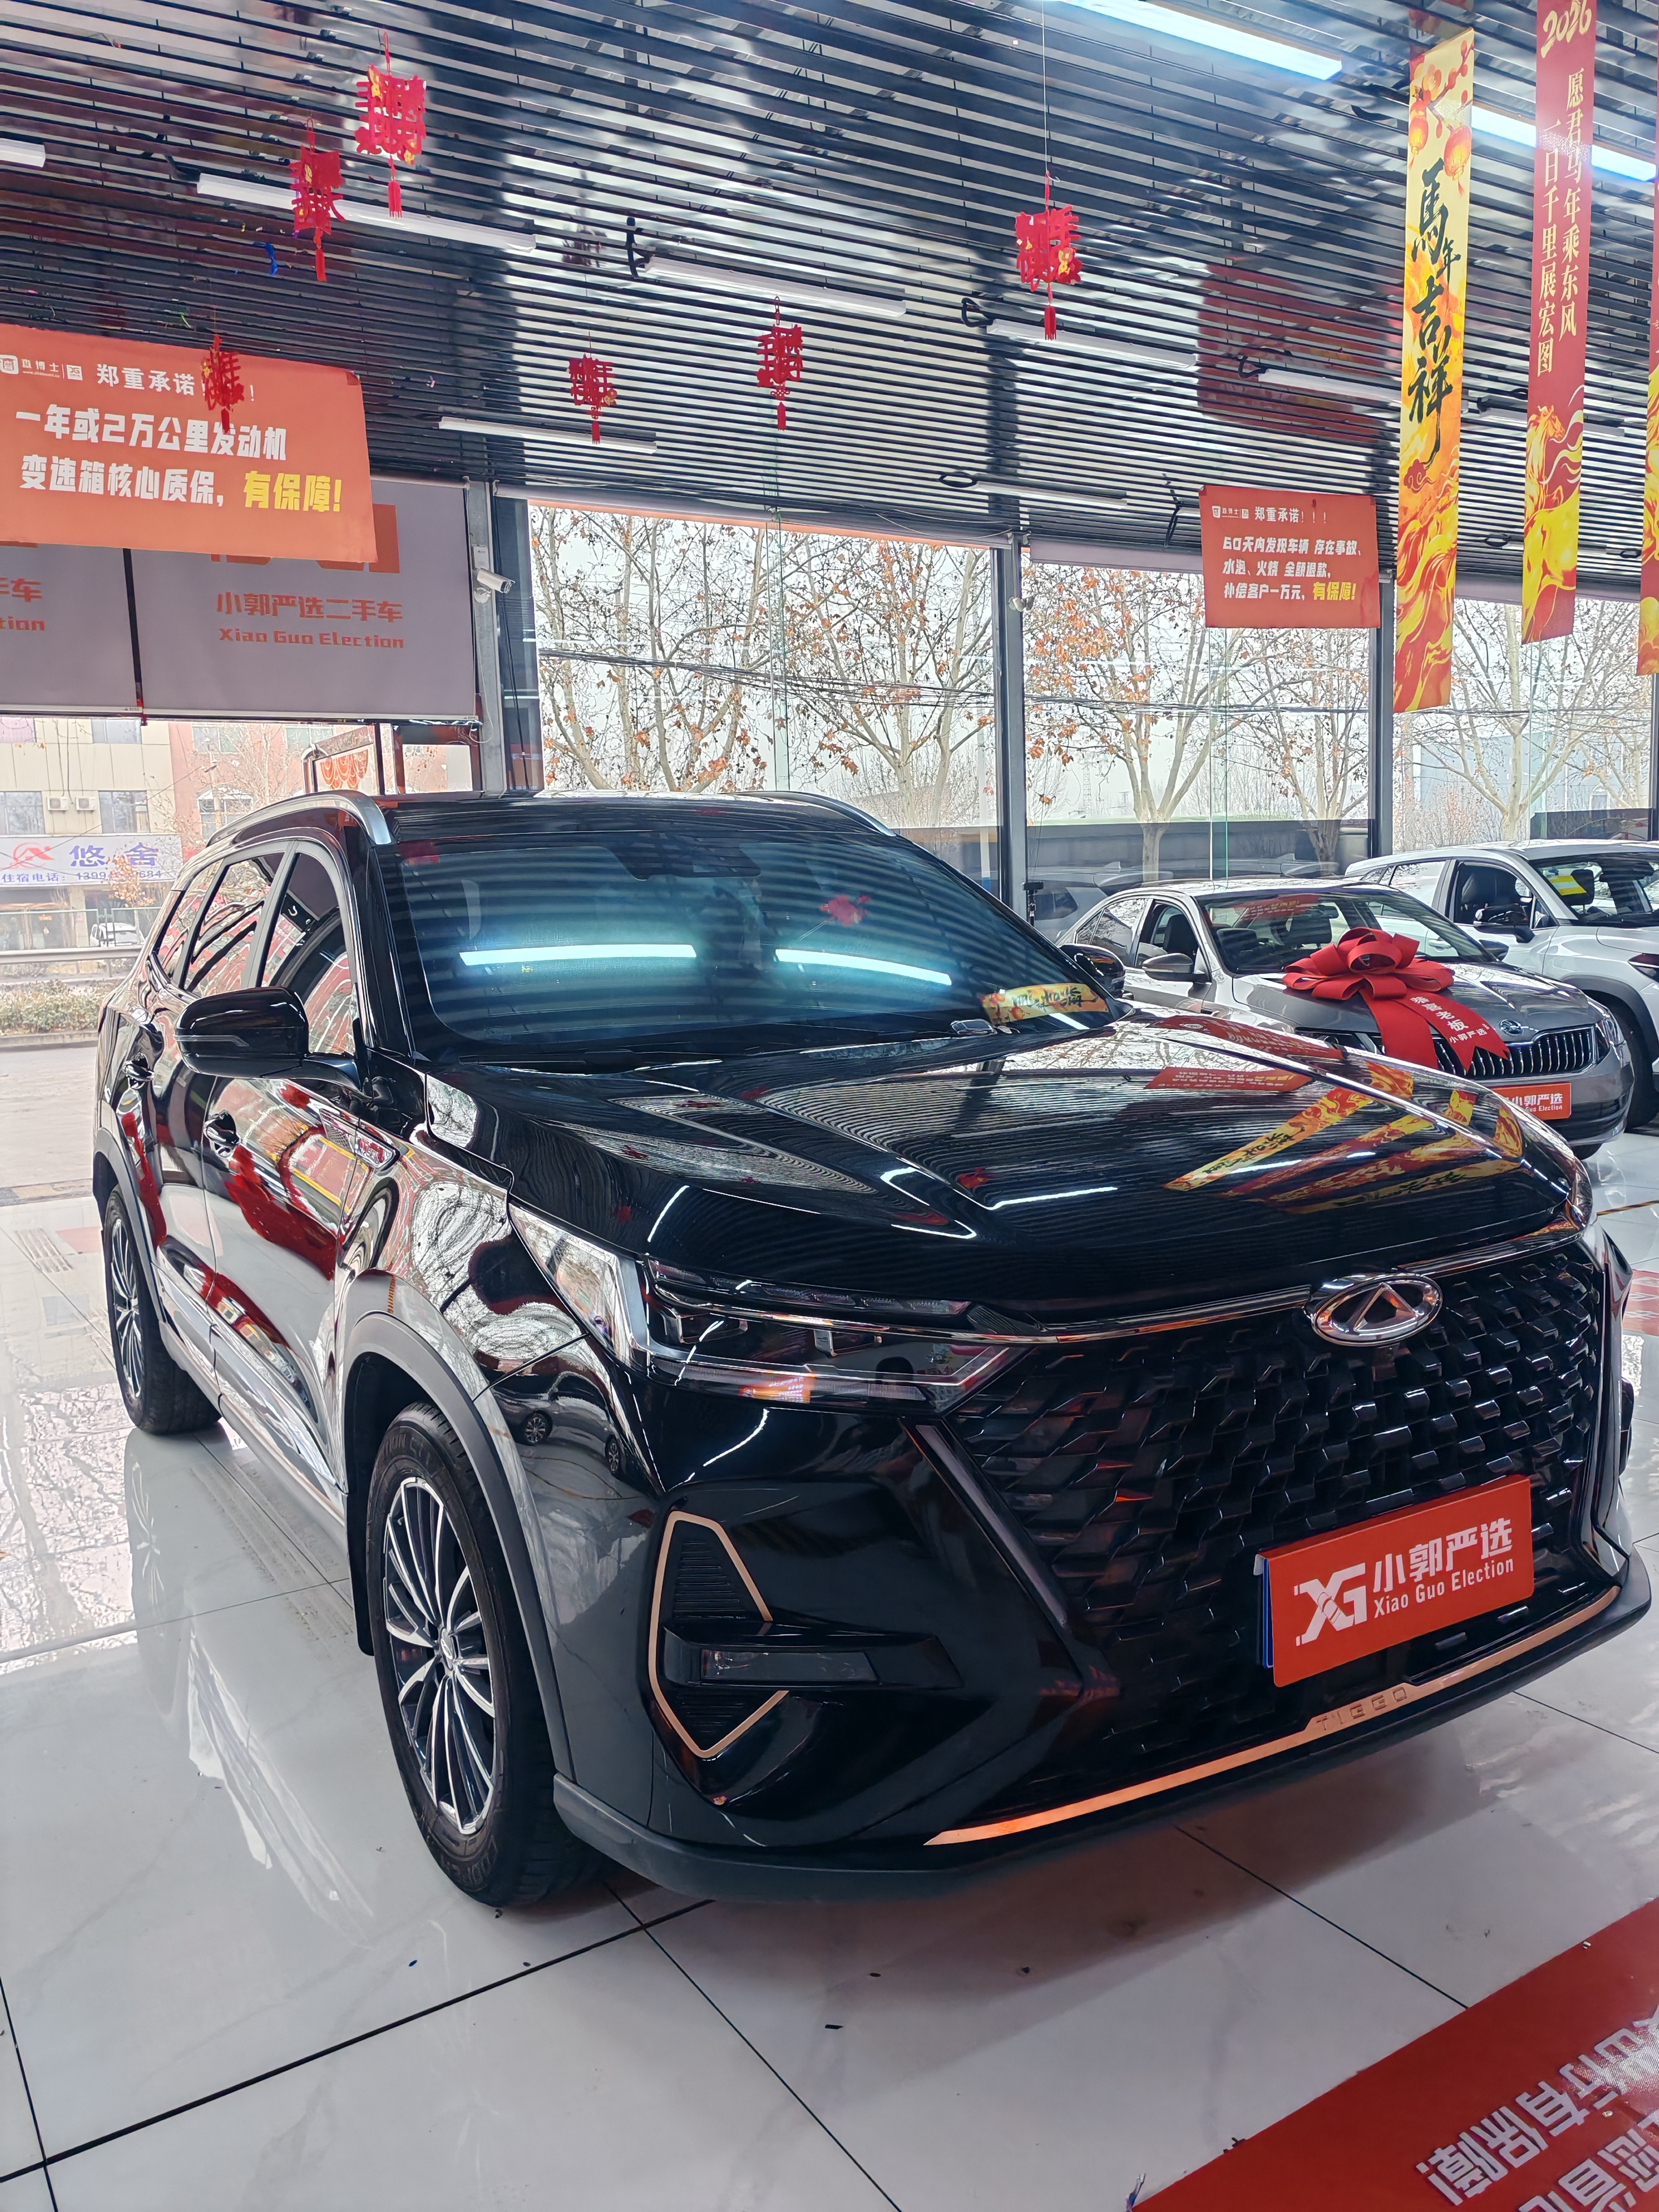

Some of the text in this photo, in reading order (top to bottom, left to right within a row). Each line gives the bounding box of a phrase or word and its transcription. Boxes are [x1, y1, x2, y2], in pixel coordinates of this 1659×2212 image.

[1541, 0, 1592, 58] 2026
[1559, 67, 1587, 342] 愿君马年乘东风
[1537, 118, 1562, 377] 一日千里展宏图
[16, 403, 287, 461] 一年或2万公里发动机
[217, 591, 403, 623] 小郭严选二手车
[219, 628, 404, 648] Xiao Guo Election
[69, 842, 159, 867] 悠舍
[1449, 1028, 1488, 1043] 小郭严选
[1512, 1092, 1563, 1107] 小郭严选
[1373, 1518, 1513, 1593] 小郭严选
[1293, 1562, 1367, 1647] XG
[1374, 1559, 1514, 1618] Xiao Guo Election
[1316, 1687, 1407, 1731] TIGGO
